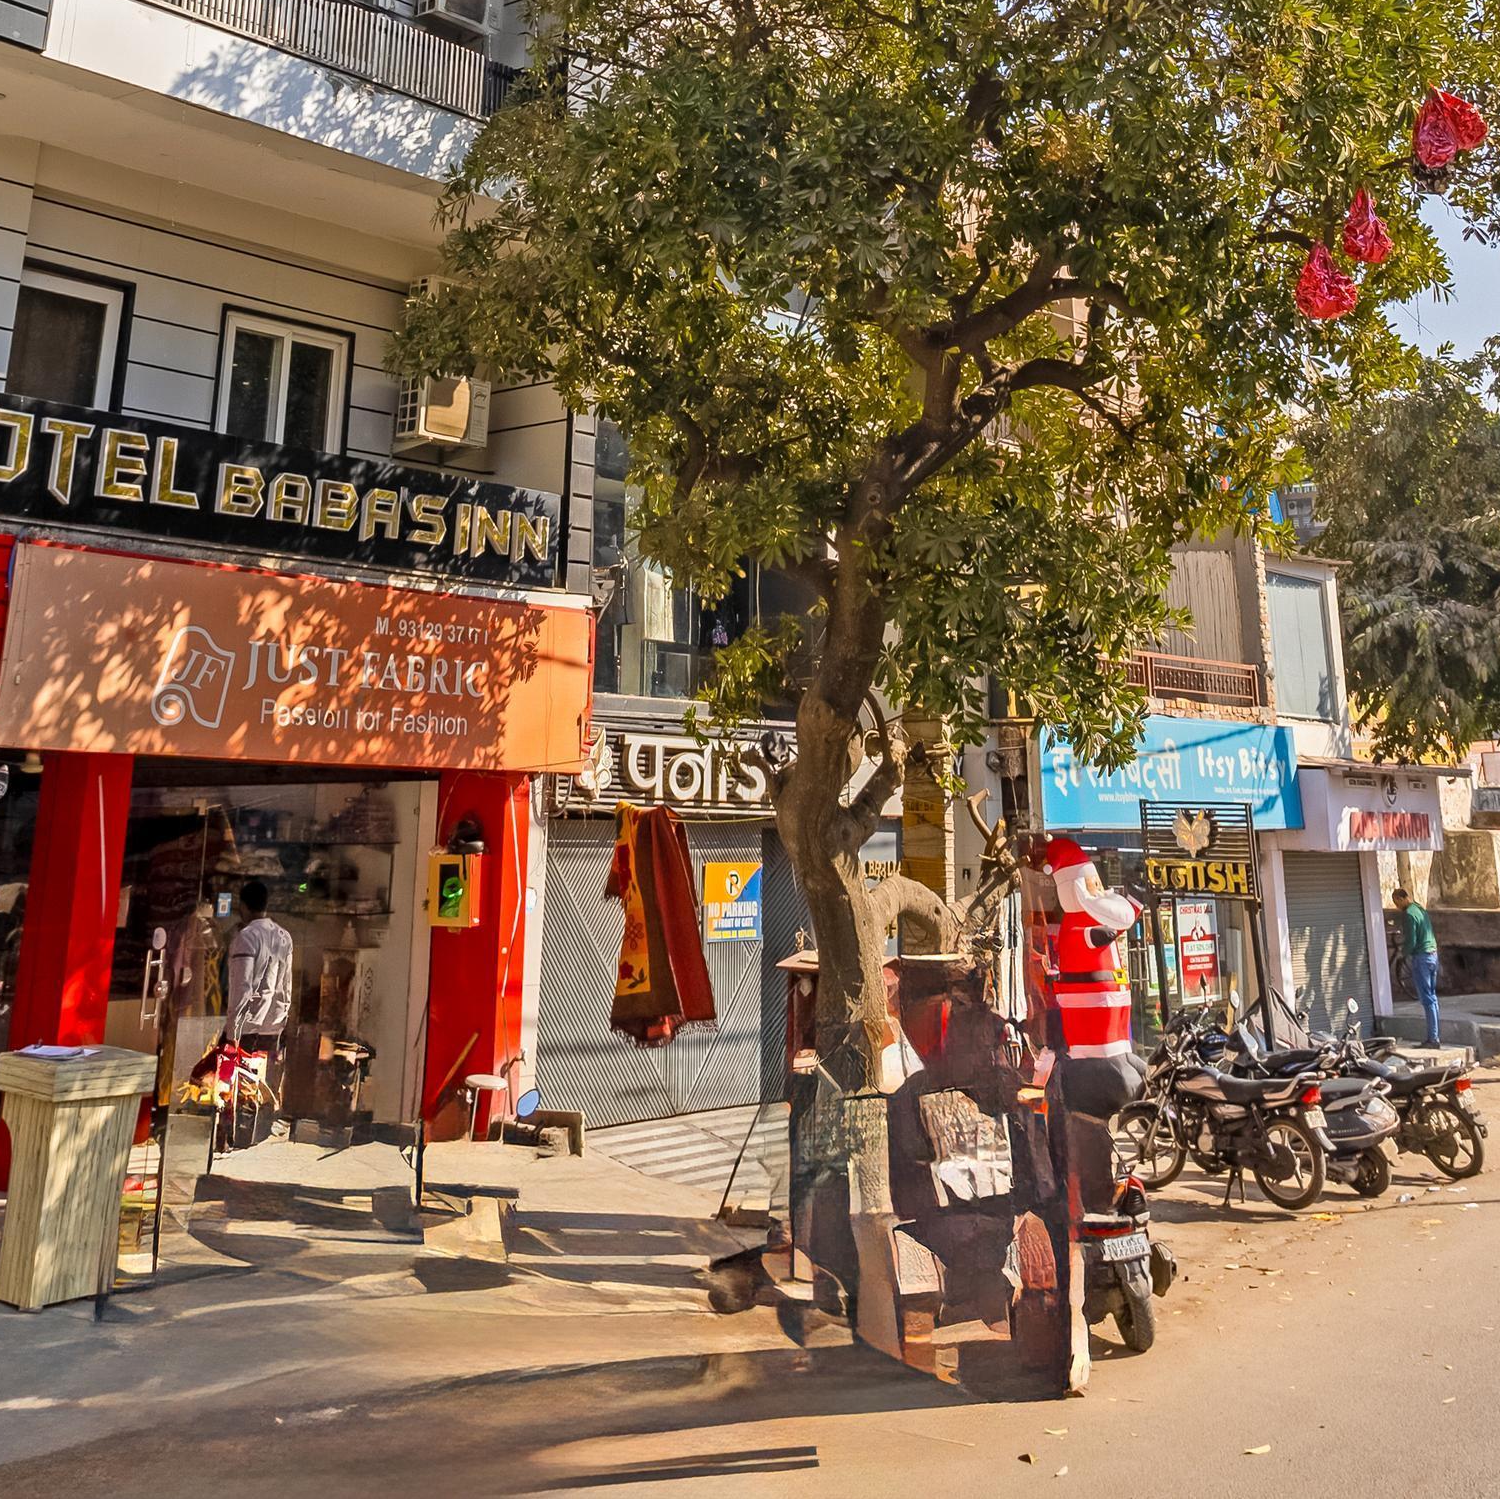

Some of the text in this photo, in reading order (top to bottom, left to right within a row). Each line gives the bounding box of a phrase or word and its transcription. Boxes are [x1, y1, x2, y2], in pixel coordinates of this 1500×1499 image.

[453, 502, 550, 563] INN
[242, 641, 348, 691] JUST
[362, 651, 487, 698] FABRIC
[356, 708, 384, 731] for
[390, 707, 468, 736] Fashion
[1197, 746, 1287, 787] Itsy Bitsy
[708, 901, 757, 917] NO PARKING
